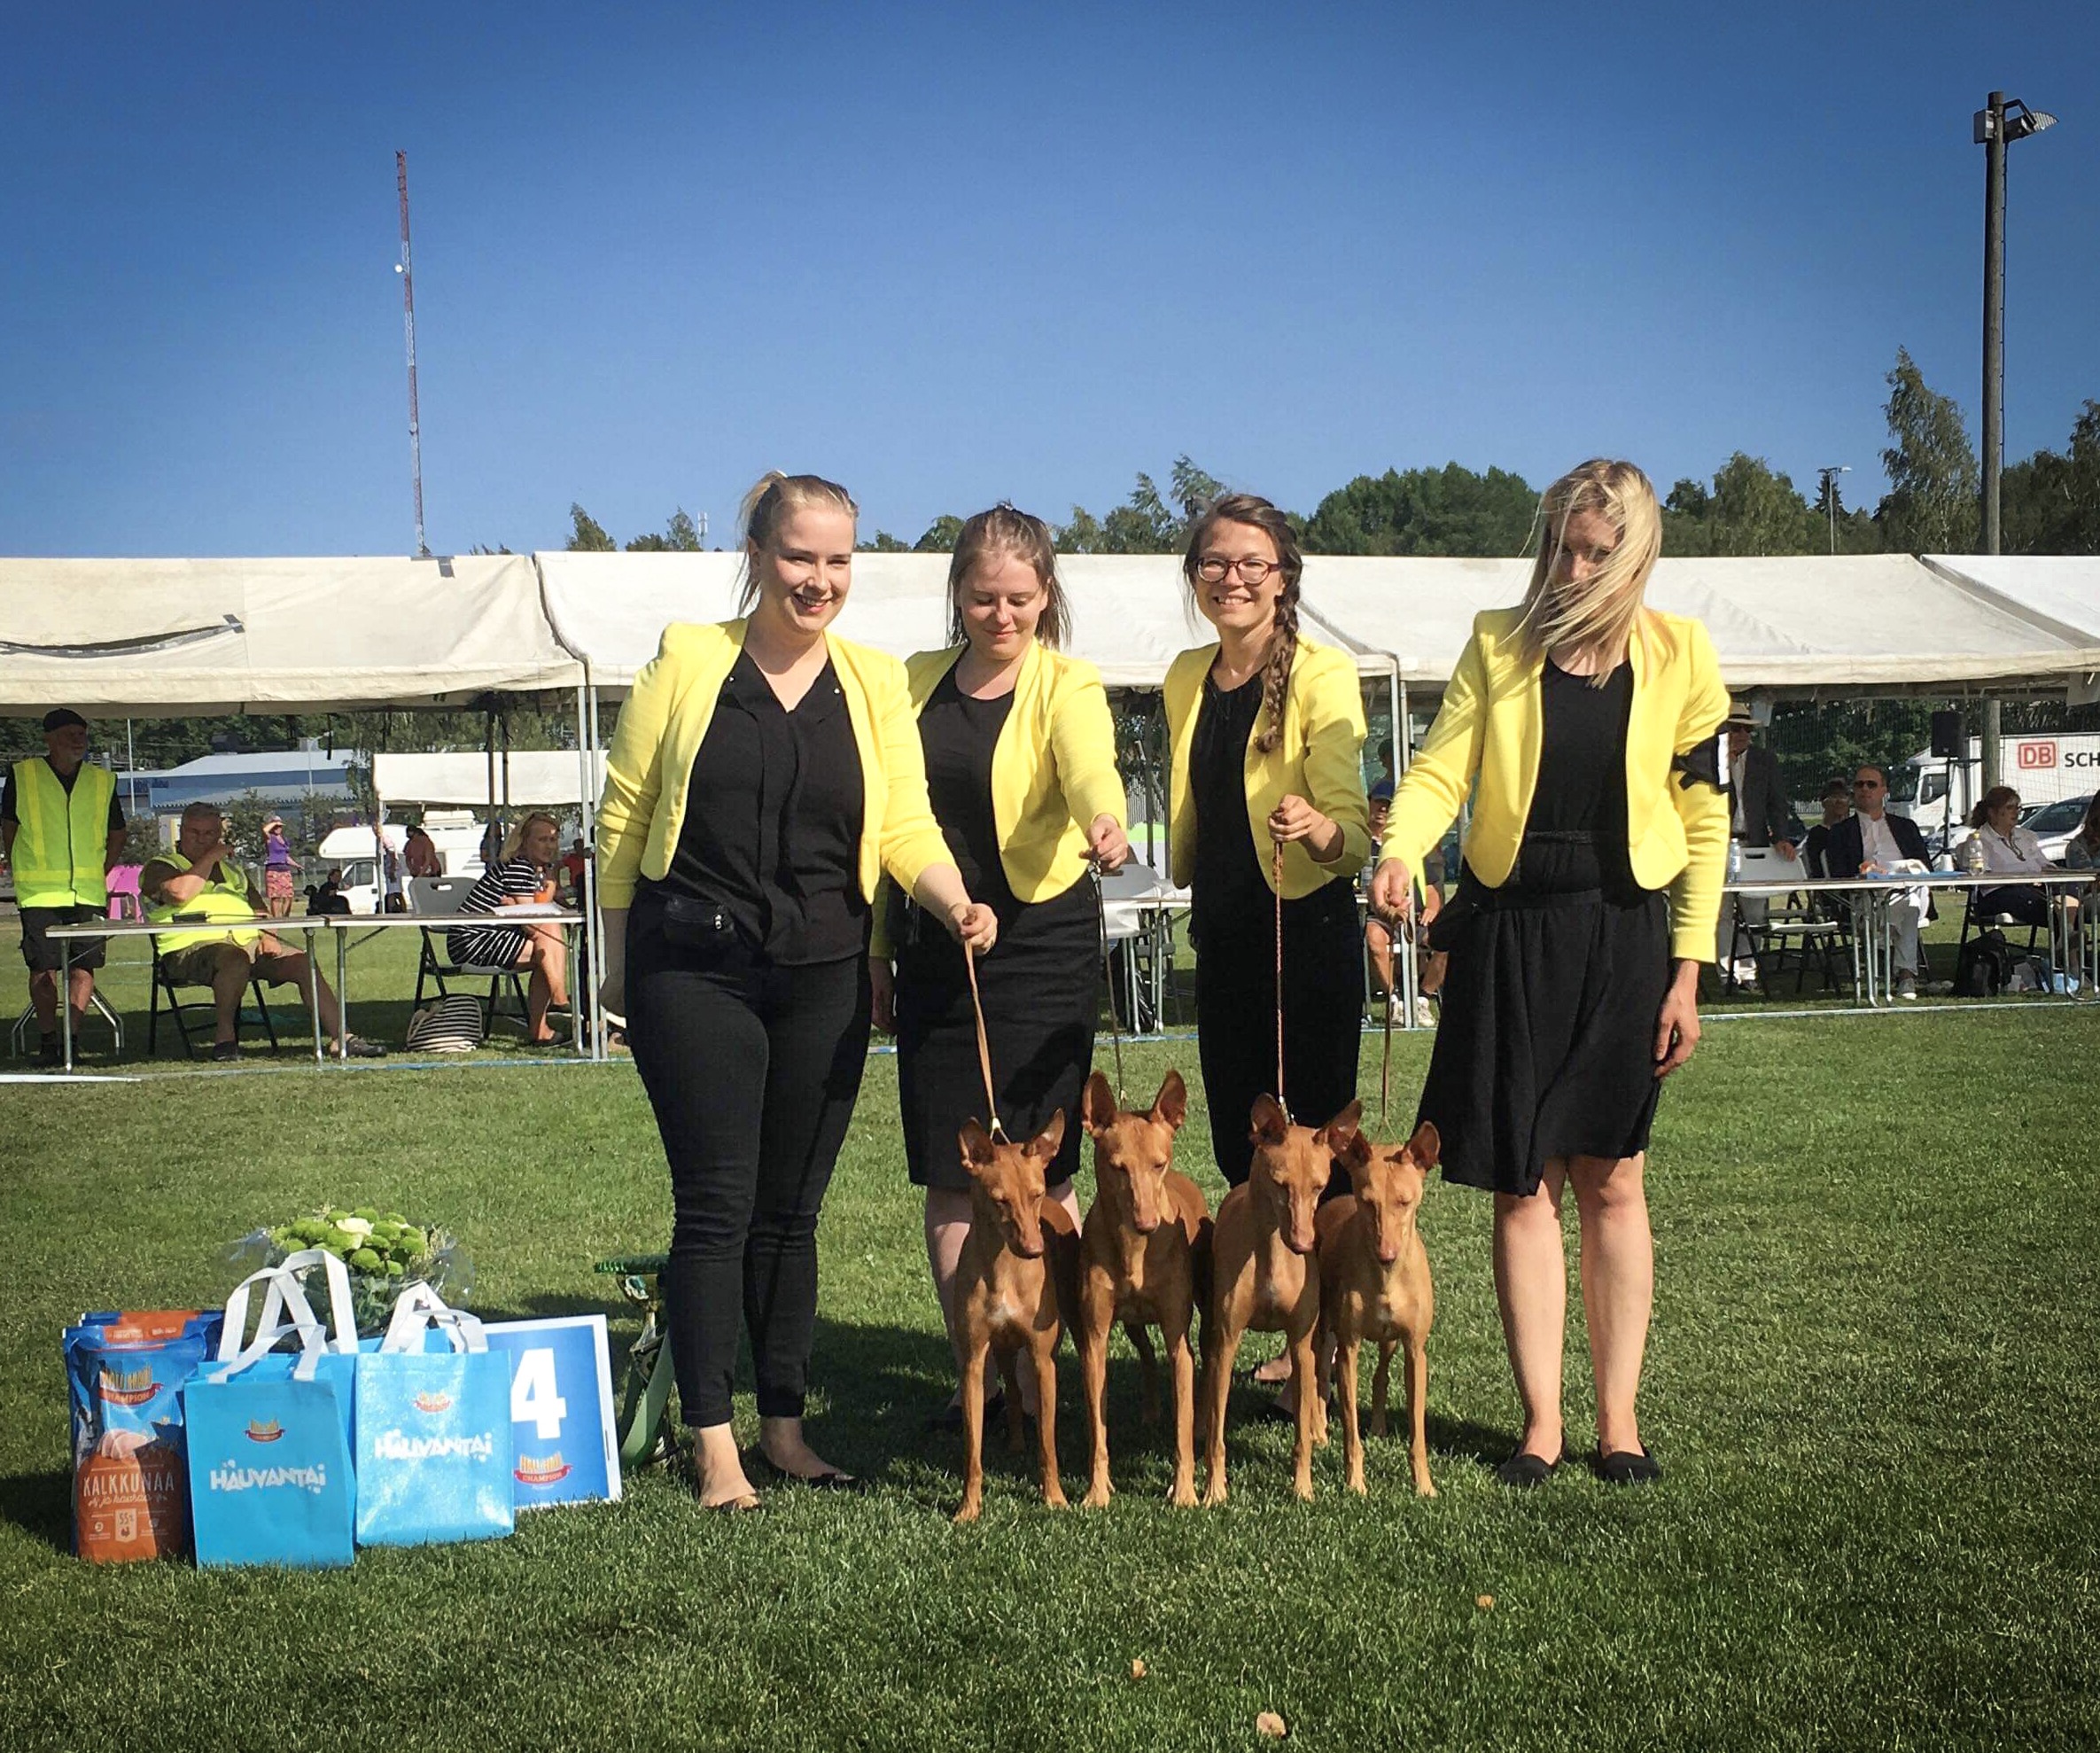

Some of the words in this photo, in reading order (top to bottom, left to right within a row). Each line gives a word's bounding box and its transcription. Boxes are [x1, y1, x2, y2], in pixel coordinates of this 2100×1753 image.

[2023, 746, 2052, 765] DB
[2064, 752, 2100, 767] SCH
[510, 1347, 567, 1439] 4
[82, 1471, 175, 1497] KALKKUNAA
